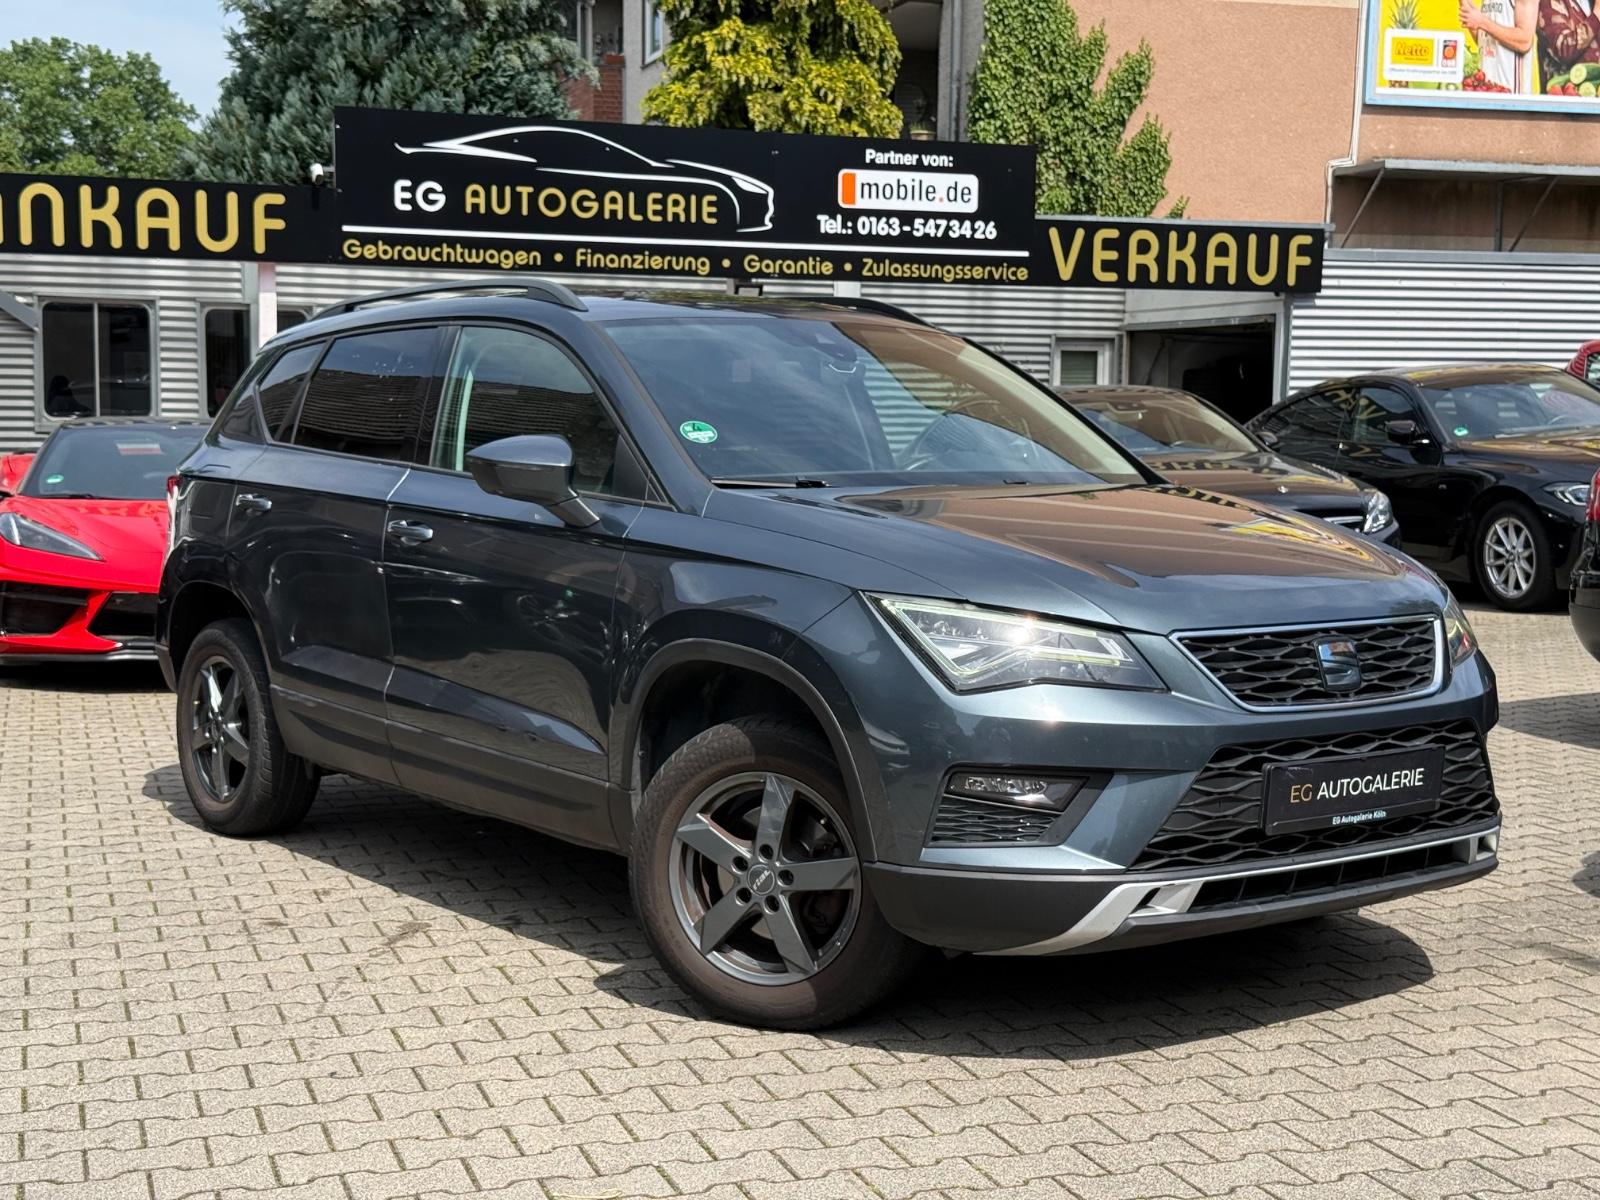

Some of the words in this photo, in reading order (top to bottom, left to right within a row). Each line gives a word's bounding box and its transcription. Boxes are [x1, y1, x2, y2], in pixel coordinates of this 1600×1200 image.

[865, 149, 919, 166] Partner
[921, 152, 954, 168] von:
[393, 179, 447, 212] EG
[464, 183, 718, 225] AUTOGALERIE
[860, 178, 972, 203] mobile.de
[0, 182, 287, 254] NKAUF
[816, 214, 853, 235] Tel.:
[342, 238, 542, 269] Gebrauchtwagen
[575, 248, 711, 276] Finanzierung
[743, 254, 834, 277] Garantie
[861, 258, 1029, 282] Zulassungsservice
[1048, 226, 1314, 287] VERKAUF
[1290, 784, 1313, 803] EG
[1317, 767, 1425, 800] AUTOGALERIE
[1341, 812, 1373, 824] Autogalerie
